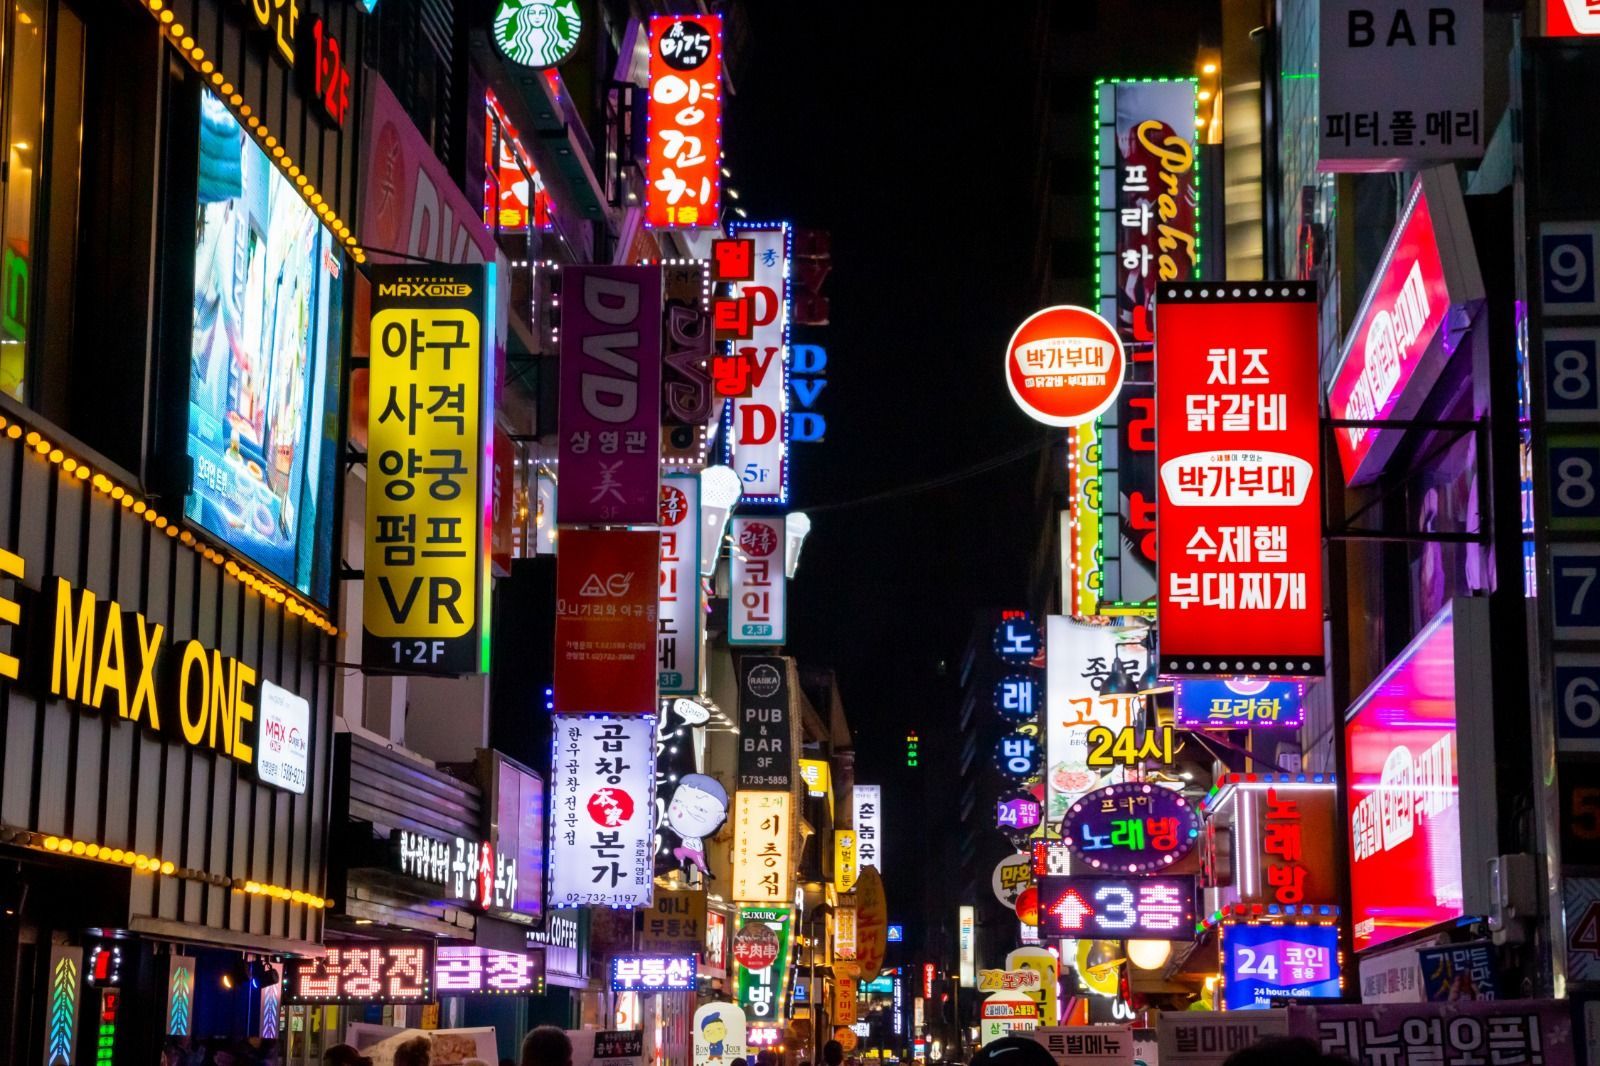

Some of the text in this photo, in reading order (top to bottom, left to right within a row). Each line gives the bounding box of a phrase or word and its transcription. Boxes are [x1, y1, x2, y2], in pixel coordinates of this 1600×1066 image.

[1348, 9, 1456, 48] BAR
[1121, 165, 1153, 277] 프라하
[1550, 244, 1587, 293] 9
[382, 319, 470, 371] 야구
[582, 274, 640, 423] DVD
[1026, 346, 1105, 369] 박가부대
[737, 285, 780, 446] DVD
[1206, 348, 1270, 385] 치즈
[1553, 350, 1591, 399] 8
[378, 384, 465, 435] 사격
[789, 344, 828, 442] DVD
[1186, 394, 1287, 432] 닭갈비
[570, 431, 647, 454] 상영관
[379, 449, 468, 501] 양궁
[590, 460, 627, 504] 美
[743, 464, 770, 482] 5F
[1178, 466, 1295, 497] 박가부대
[1557, 457, 1596, 507] 8
[375, 514, 466, 566] 펌프
[1186, 526, 1288, 562] 수제햄
[378, 577, 464, 624] VR
[742, 560, 771, 622] 코인
[1169, 572, 1306, 609] 부대찌개
[1561, 568, 1597, 615] 7
[51, 576, 164, 731] MAX
[179, 639, 256, 764] ONE
[745, 708, 782, 723] PUB
[1003, 625, 1034, 773] 노래방
[1208, 697, 1282, 721] 프라하
[1563, 677, 1600, 729] 6
[744, 738, 782, 752] BAR
[760, 726, 767, 736] &
[1087, 725, 1174, 766] 24시
[593, 724, 631, 785] 곱창
[757, 757, 773, 768] 3F
[999, 804, 1017, 825] 24
[1082, 816, 1180, 850] 노래방
[590, 831, 628, 888] 본가
[757, 814, 783, 897] 이층집
[1264, 787, 1308, 904] 노래방
[566, 893, 638, 902] 02-732-1197
[1095, 885, 1182, 929] 3층
[551, 915, 577, 949] COFFEE
[651, 920, 698, 937] 부동산
[616, 959, 692, 987] 부동산
[1237, 947, 1323, 980] 24 코인
[1254, 987, 1311, 997] 24 hours Coin
[1048, 1034, 1121, 1056] 특별메뉴
[1175, 1025, 1260, 1053] 별미메
